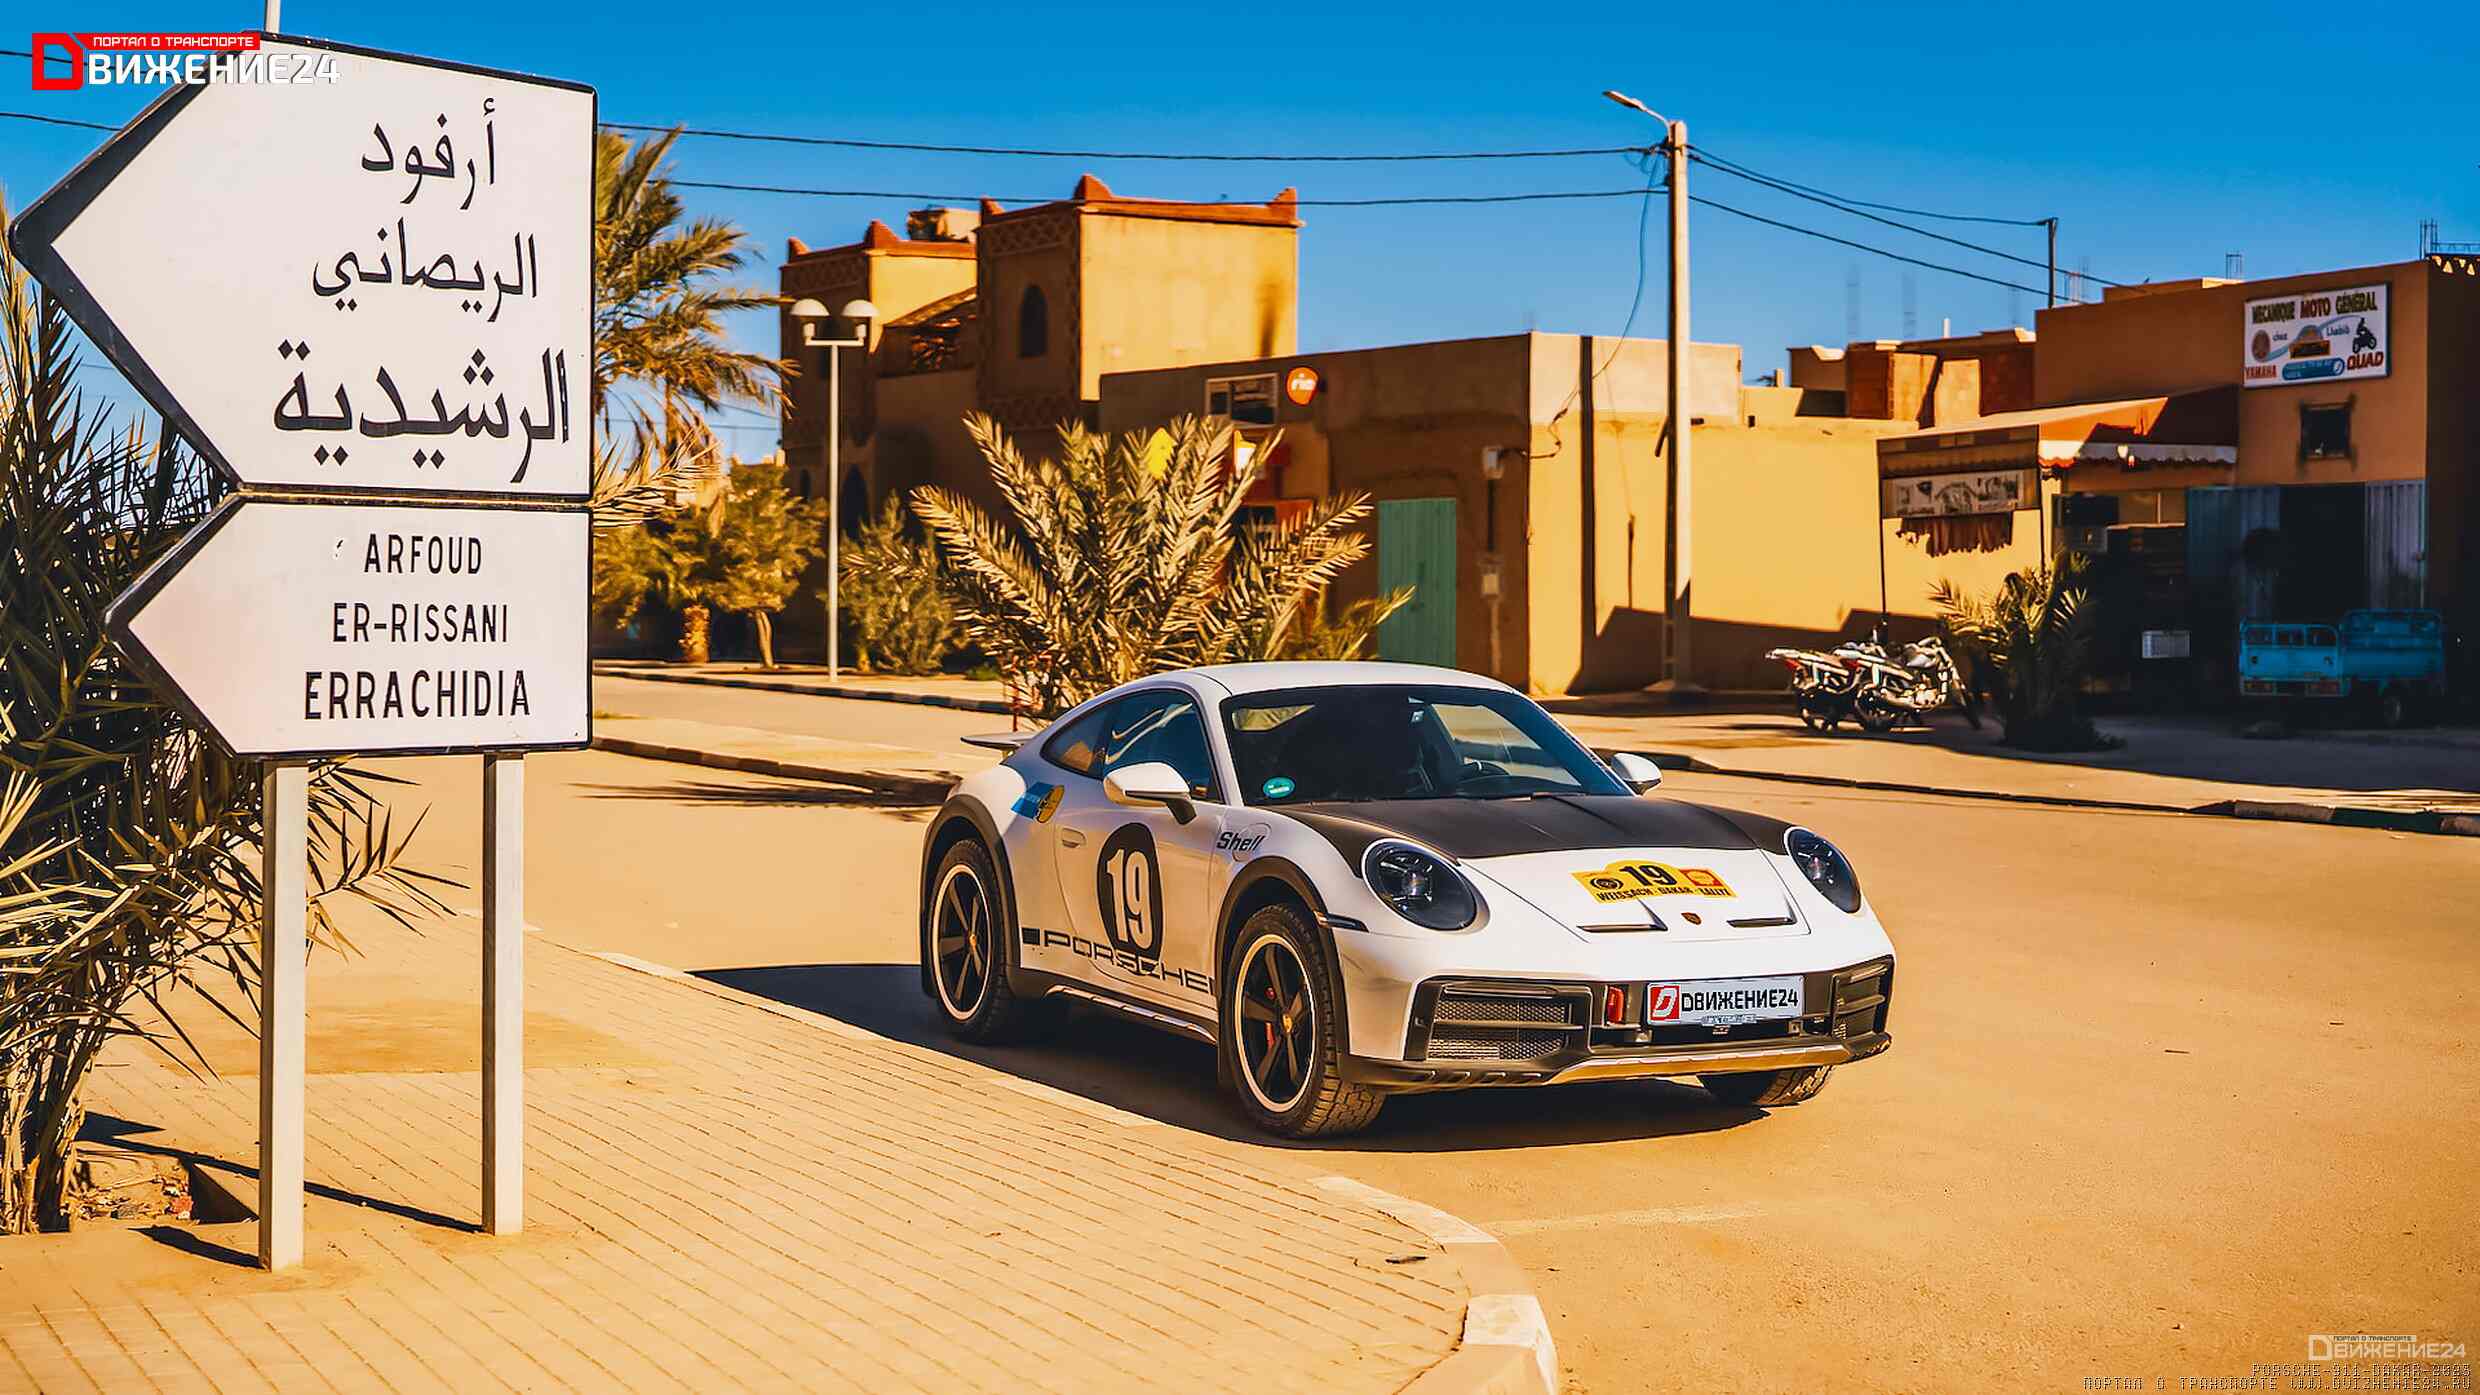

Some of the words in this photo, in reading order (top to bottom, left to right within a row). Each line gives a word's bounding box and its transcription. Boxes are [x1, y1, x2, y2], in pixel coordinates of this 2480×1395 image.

[361, 97, 495, 210] أرفود
[313, 217, 537, 323] الريصاني
[2300, 297, 2331, 319] MOTO
[2346, 351, 2384, 371] QUAD
[273, 339, 569, 483] الرشيدية
[364, 533, 482, 575] ARFOUD
[333, 602, 508, 643] ER-RISSANI
[304, 669, 530, 720] ERRACHIDIA
[1216, 831, 1266, 852] Shell
[1619, 864, 1678, 887] 19
[1106, 848, 1154, 950] 19
[1043, 930, 1209, 993] PORSCHE
